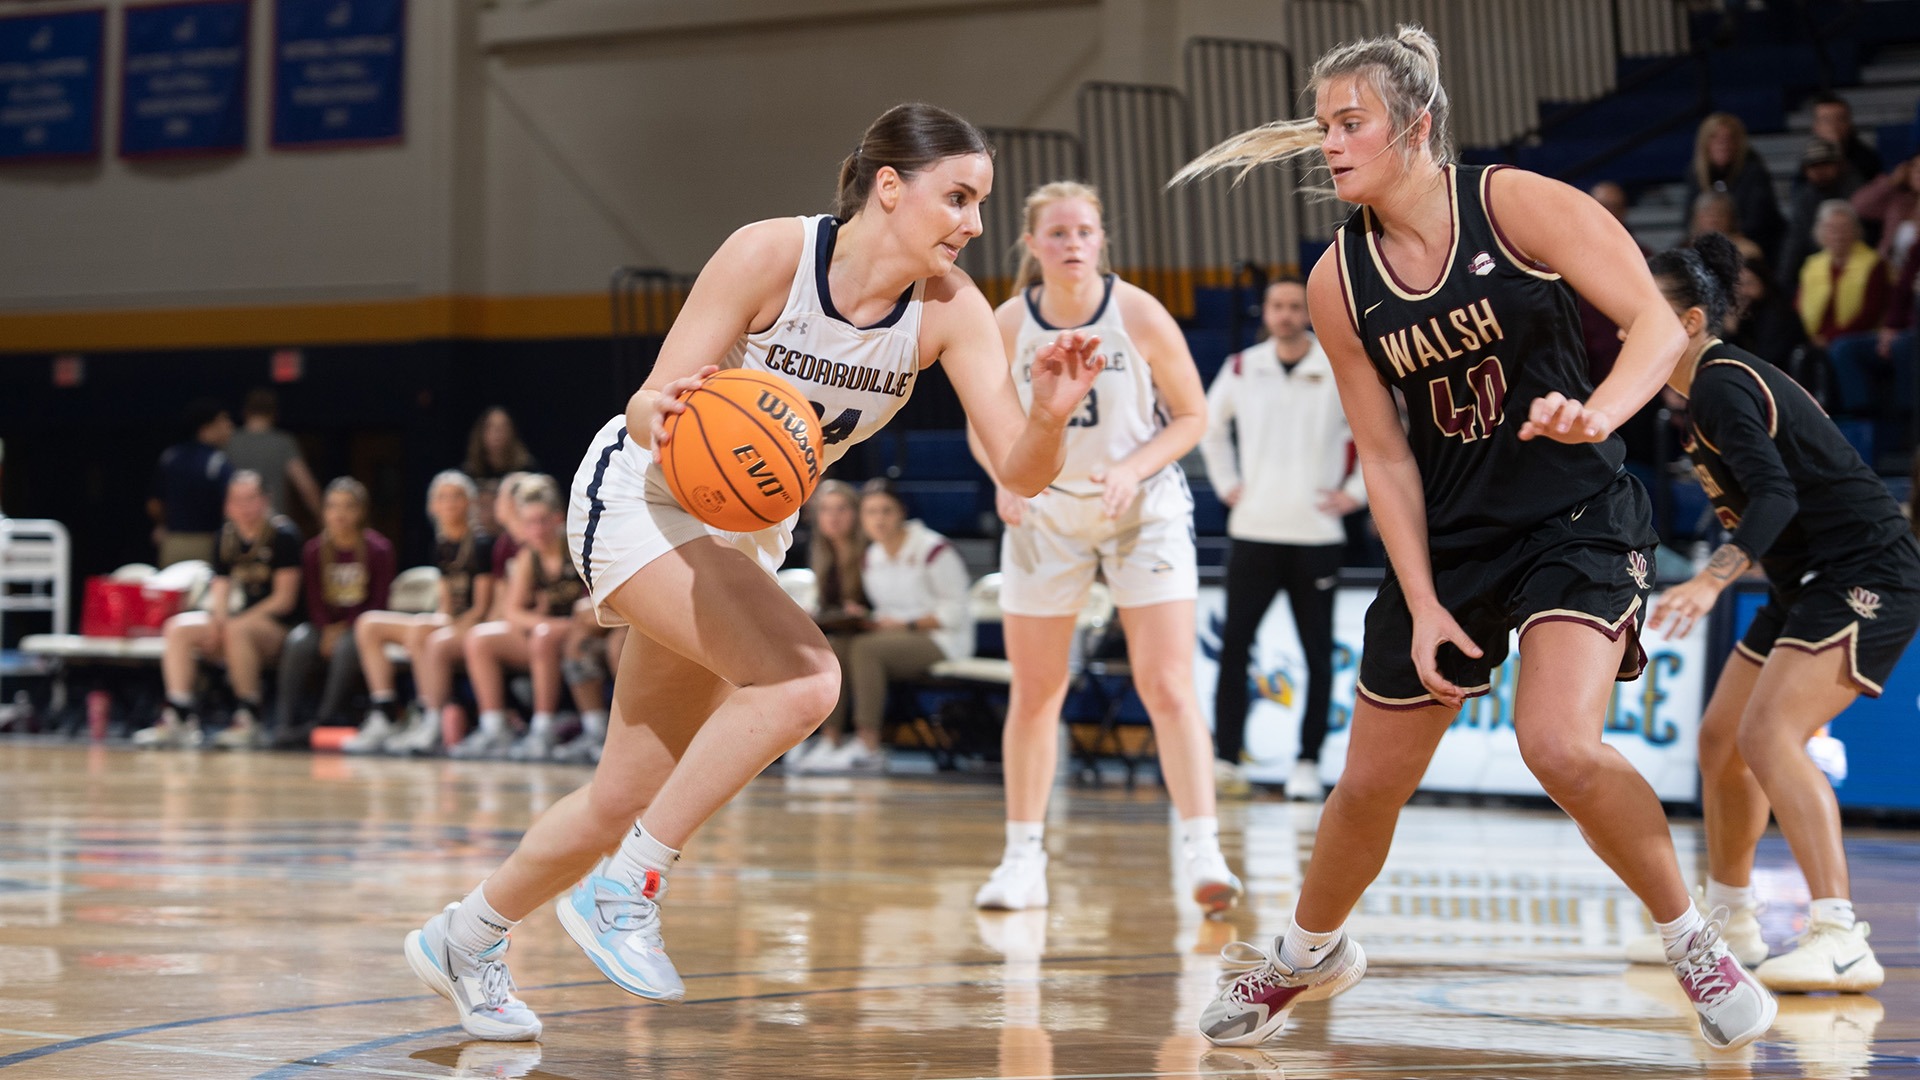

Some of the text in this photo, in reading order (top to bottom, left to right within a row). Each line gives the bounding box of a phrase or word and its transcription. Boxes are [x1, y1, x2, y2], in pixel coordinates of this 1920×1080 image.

[1379, 298, 1504, 378] WALSH
[765, 344, 913, 397] CEDARVILLE
[808, 400, 863, 445] 4
[1067, 388, 1098, 427] 3
[1429, 355, 1507, 443] 40
[757, 389, 818, 484] Wilson
[732, 443, 784, 497] EVO
